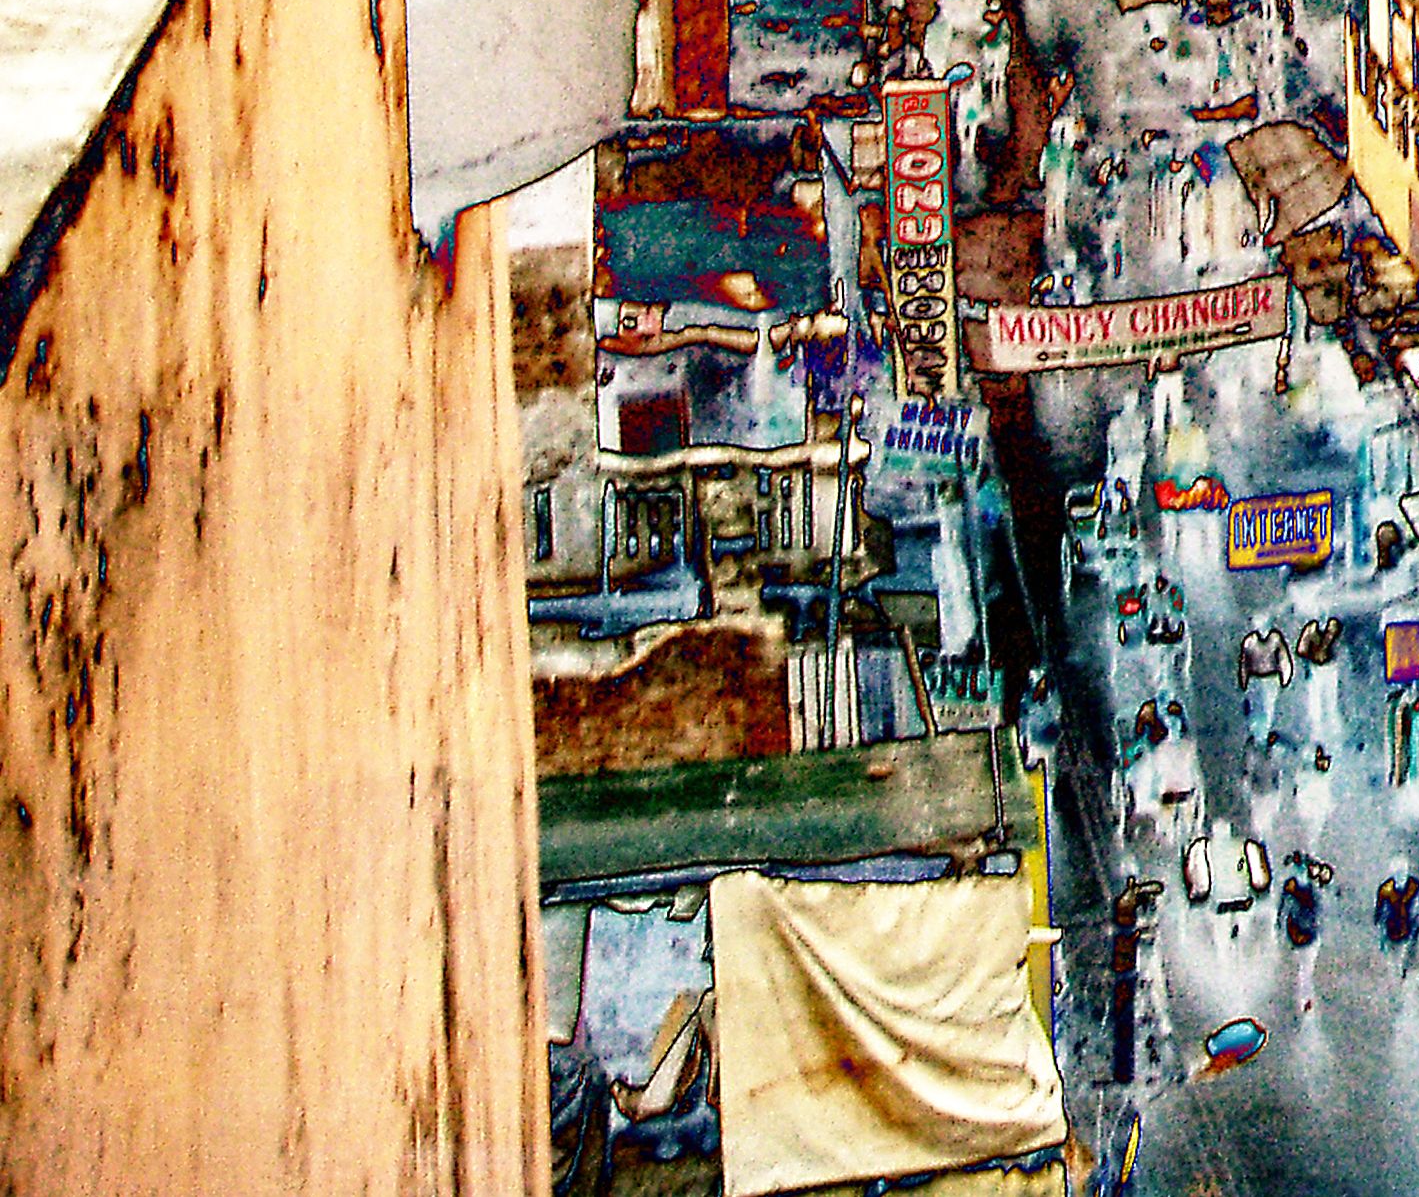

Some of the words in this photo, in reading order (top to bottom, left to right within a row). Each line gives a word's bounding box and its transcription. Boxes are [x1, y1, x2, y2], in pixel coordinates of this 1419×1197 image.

[999, 309, 1115, 345] MONEY
[1130, 286, 1273, 335] CHANGER
[1234, 504, 1328, 549] INTERNET
